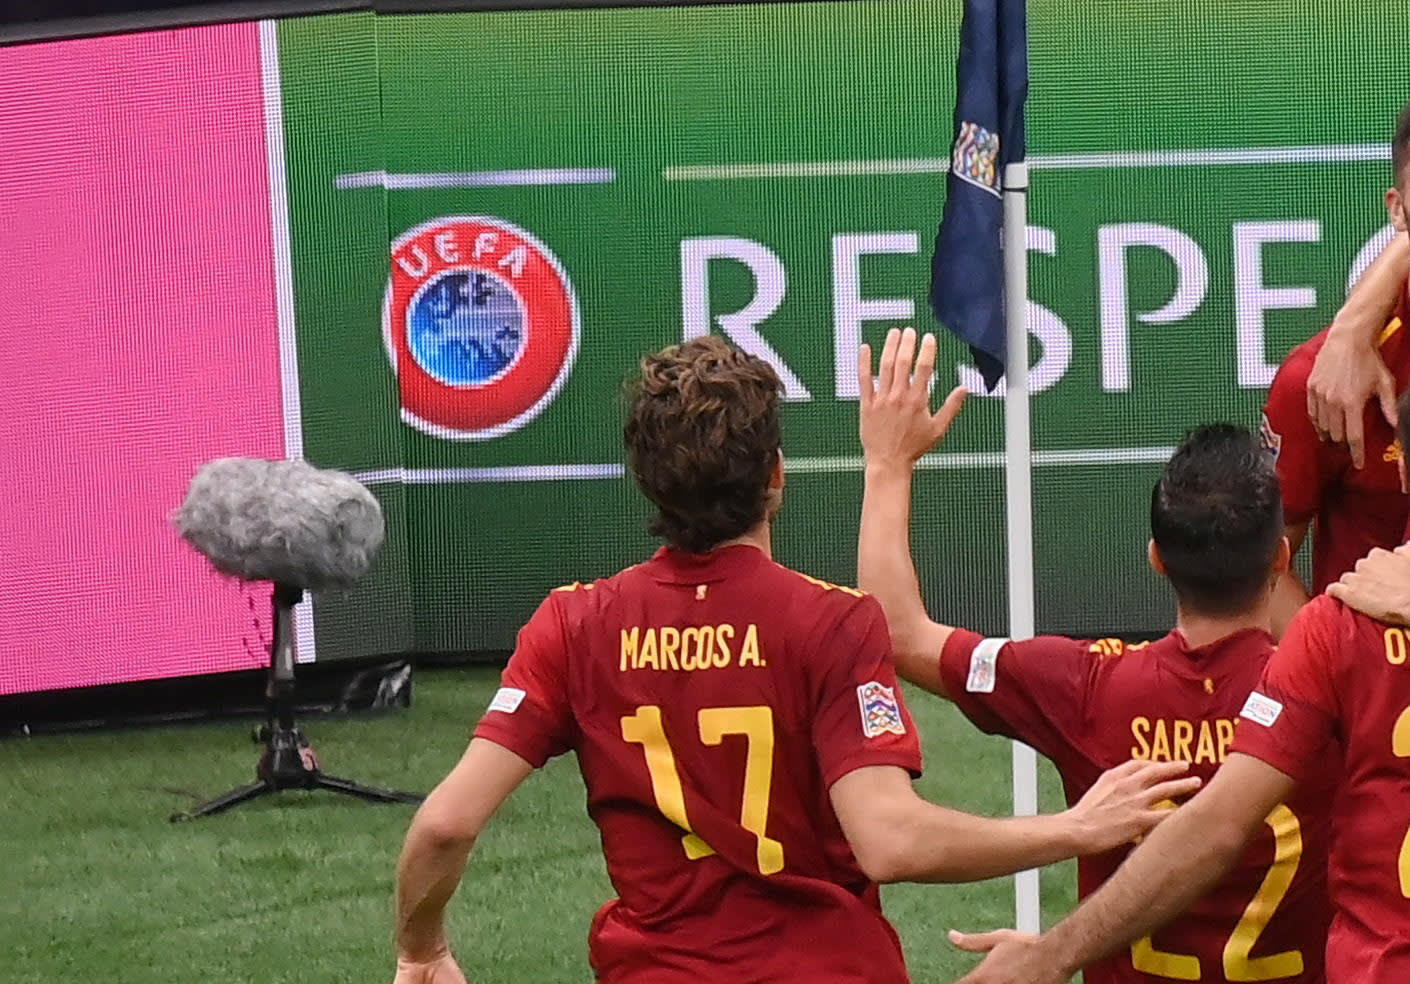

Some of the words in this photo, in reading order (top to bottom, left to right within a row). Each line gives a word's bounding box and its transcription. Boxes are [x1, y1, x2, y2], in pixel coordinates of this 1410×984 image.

[395, 229, 528, 279] UEFA
[619, 623, 735, 672] MARCOS
[738, 623, 767, 668] A.
[620, 704, 785, 876] 17
